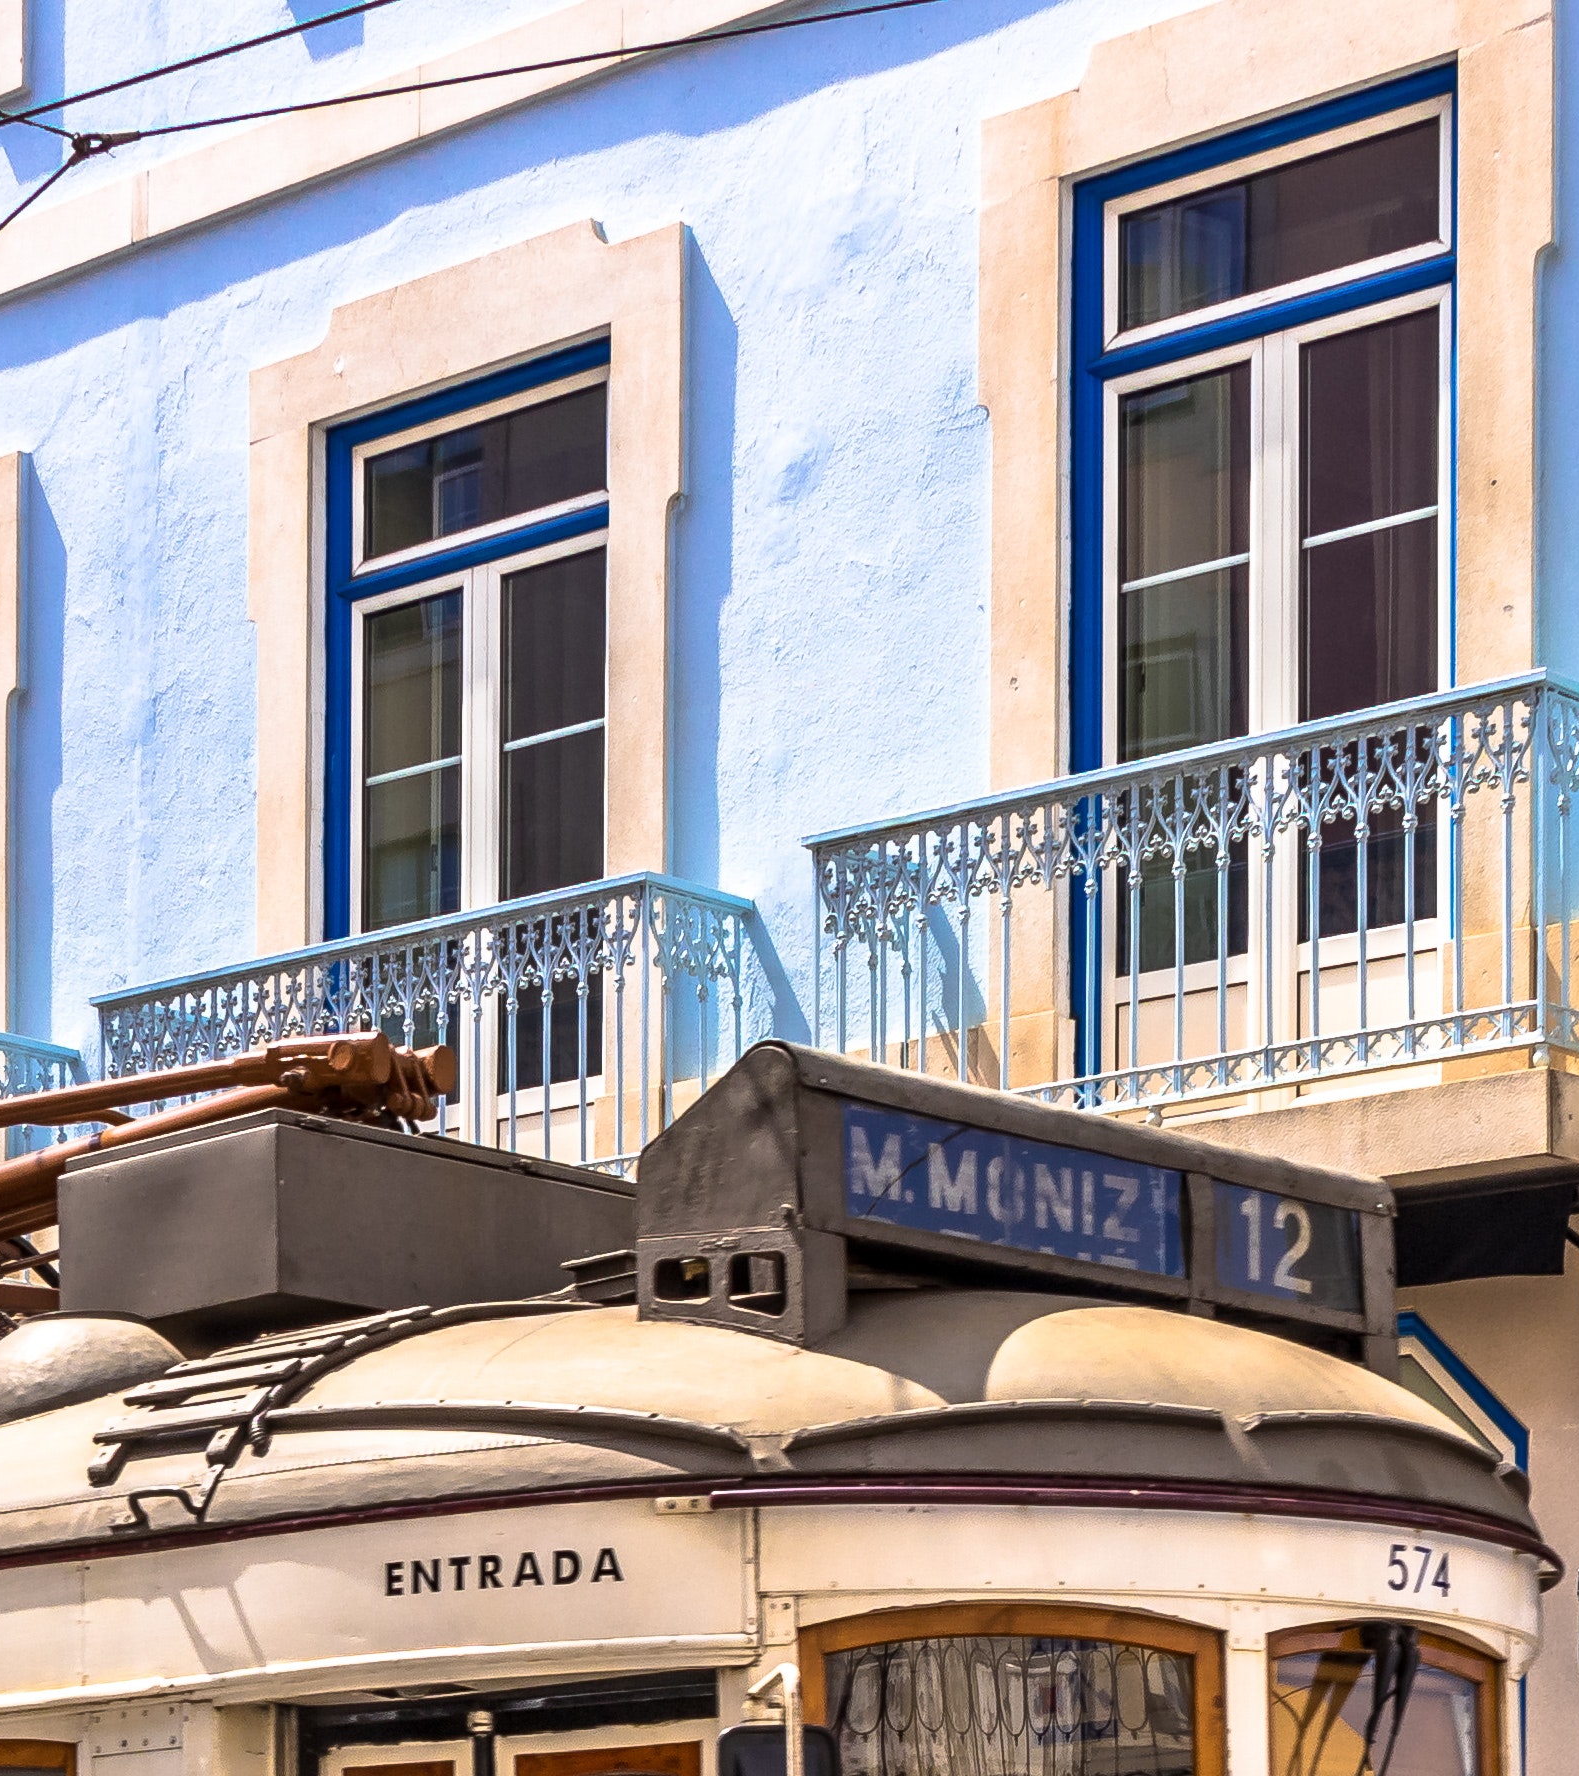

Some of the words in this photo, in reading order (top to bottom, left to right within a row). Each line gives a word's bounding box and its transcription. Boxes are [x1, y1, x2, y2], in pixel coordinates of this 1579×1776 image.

[849, 1125, 915, 1203] M.
[927, 1141, 1141, 1244] MONIZ
[1239, 1190, 1313, 1294] 12
[384, 1547, 624, 1597] ENTRADA
[1387, 1543, 1451, 1598] 574
